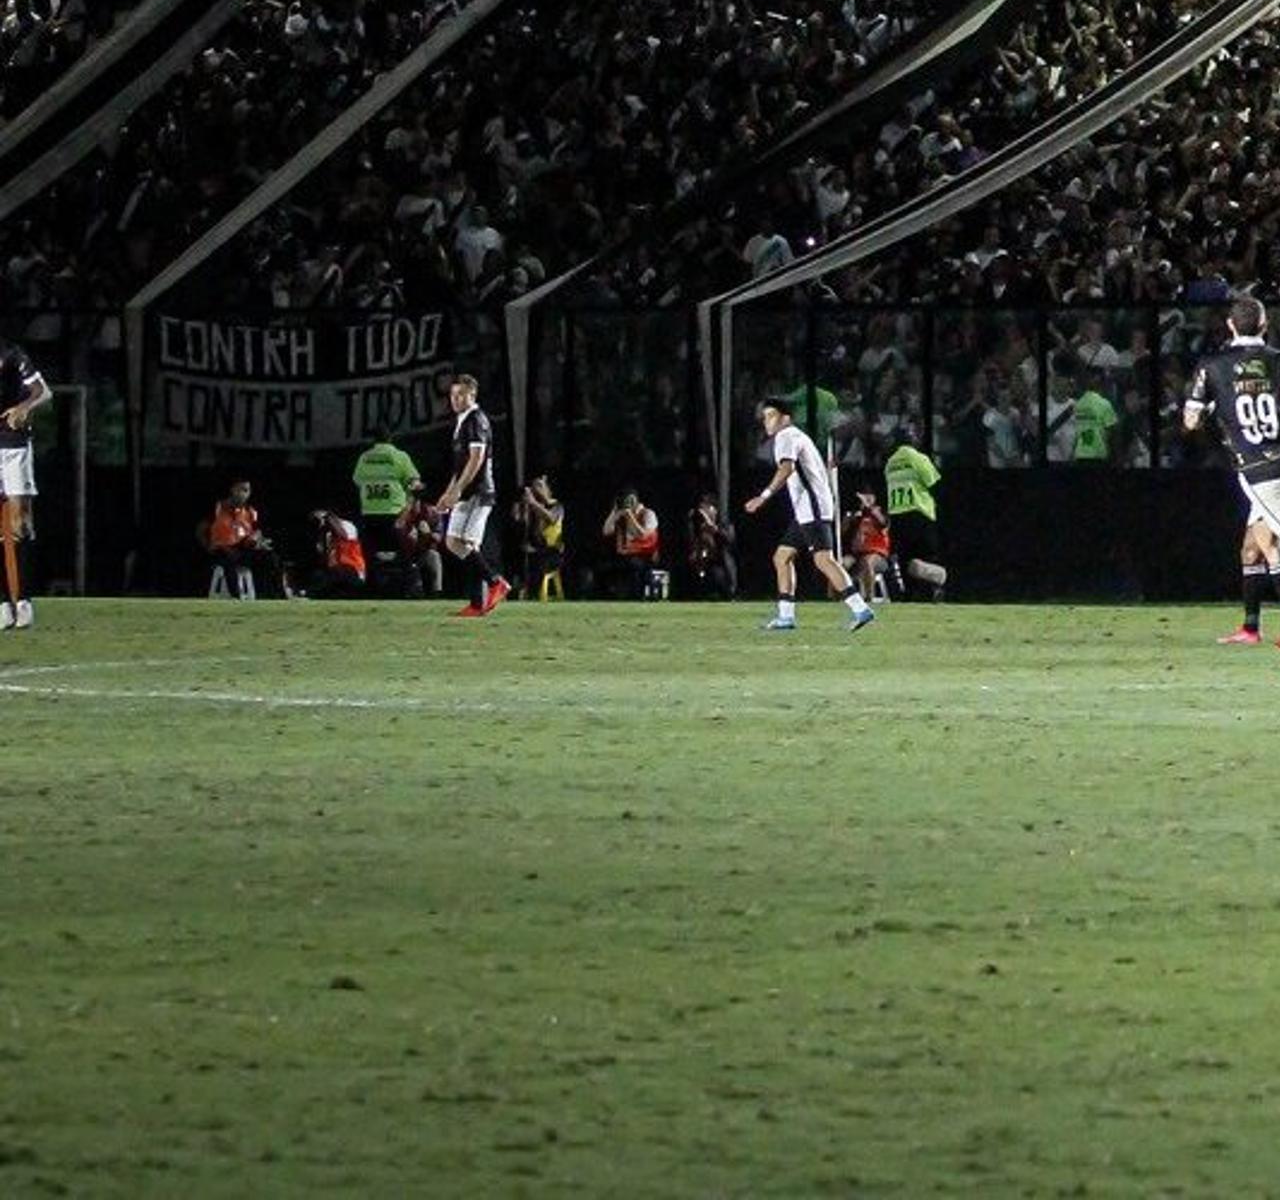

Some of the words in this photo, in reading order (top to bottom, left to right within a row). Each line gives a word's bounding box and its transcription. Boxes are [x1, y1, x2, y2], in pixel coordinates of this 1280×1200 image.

[160, 315, 316, 377] CONTRA
[163, 377, 312, 443] CONTRA
[1235, 393, 1279, 445] 99
